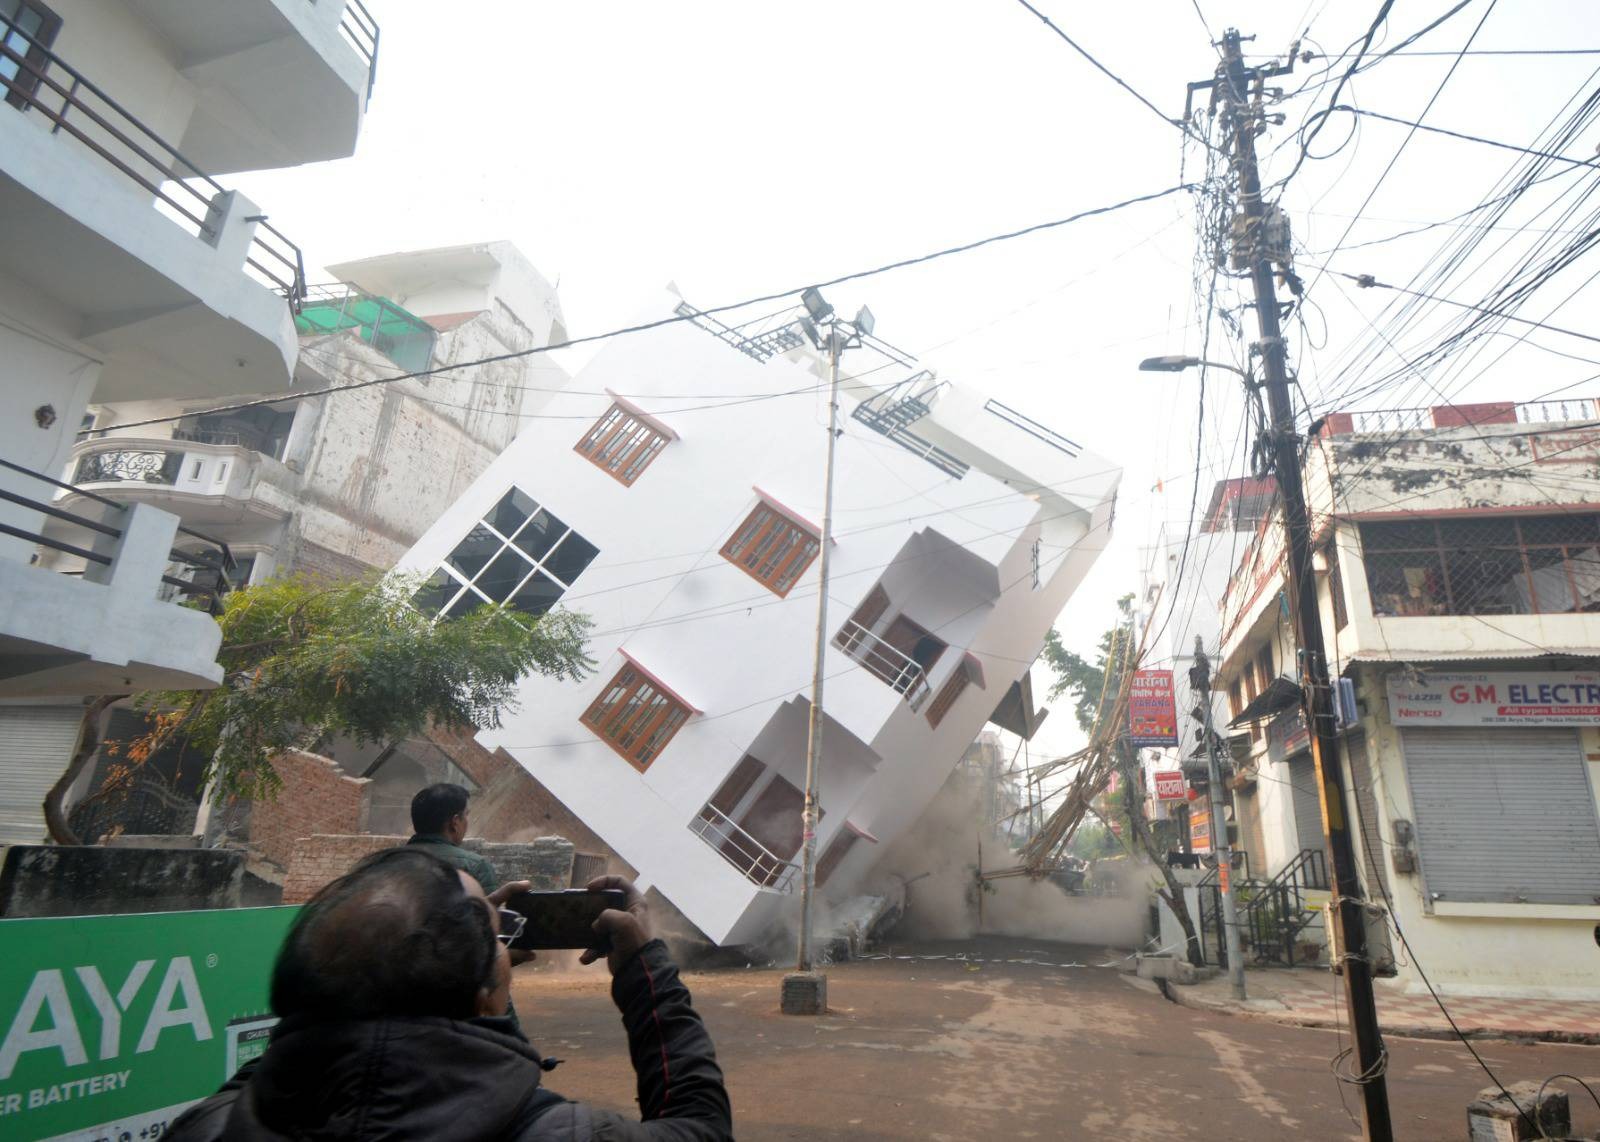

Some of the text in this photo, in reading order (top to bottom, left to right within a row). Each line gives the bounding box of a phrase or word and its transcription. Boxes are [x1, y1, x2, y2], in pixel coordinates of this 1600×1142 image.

[1450, 684, 1600, 704] G.M. ELECTR
[1521, 707, 1549, 716] types
[1551, 706, 1598, 714] Electrical
[0, 956, 214, 1080] AYA
[28, 1069, 132, 1110] BATTERY
